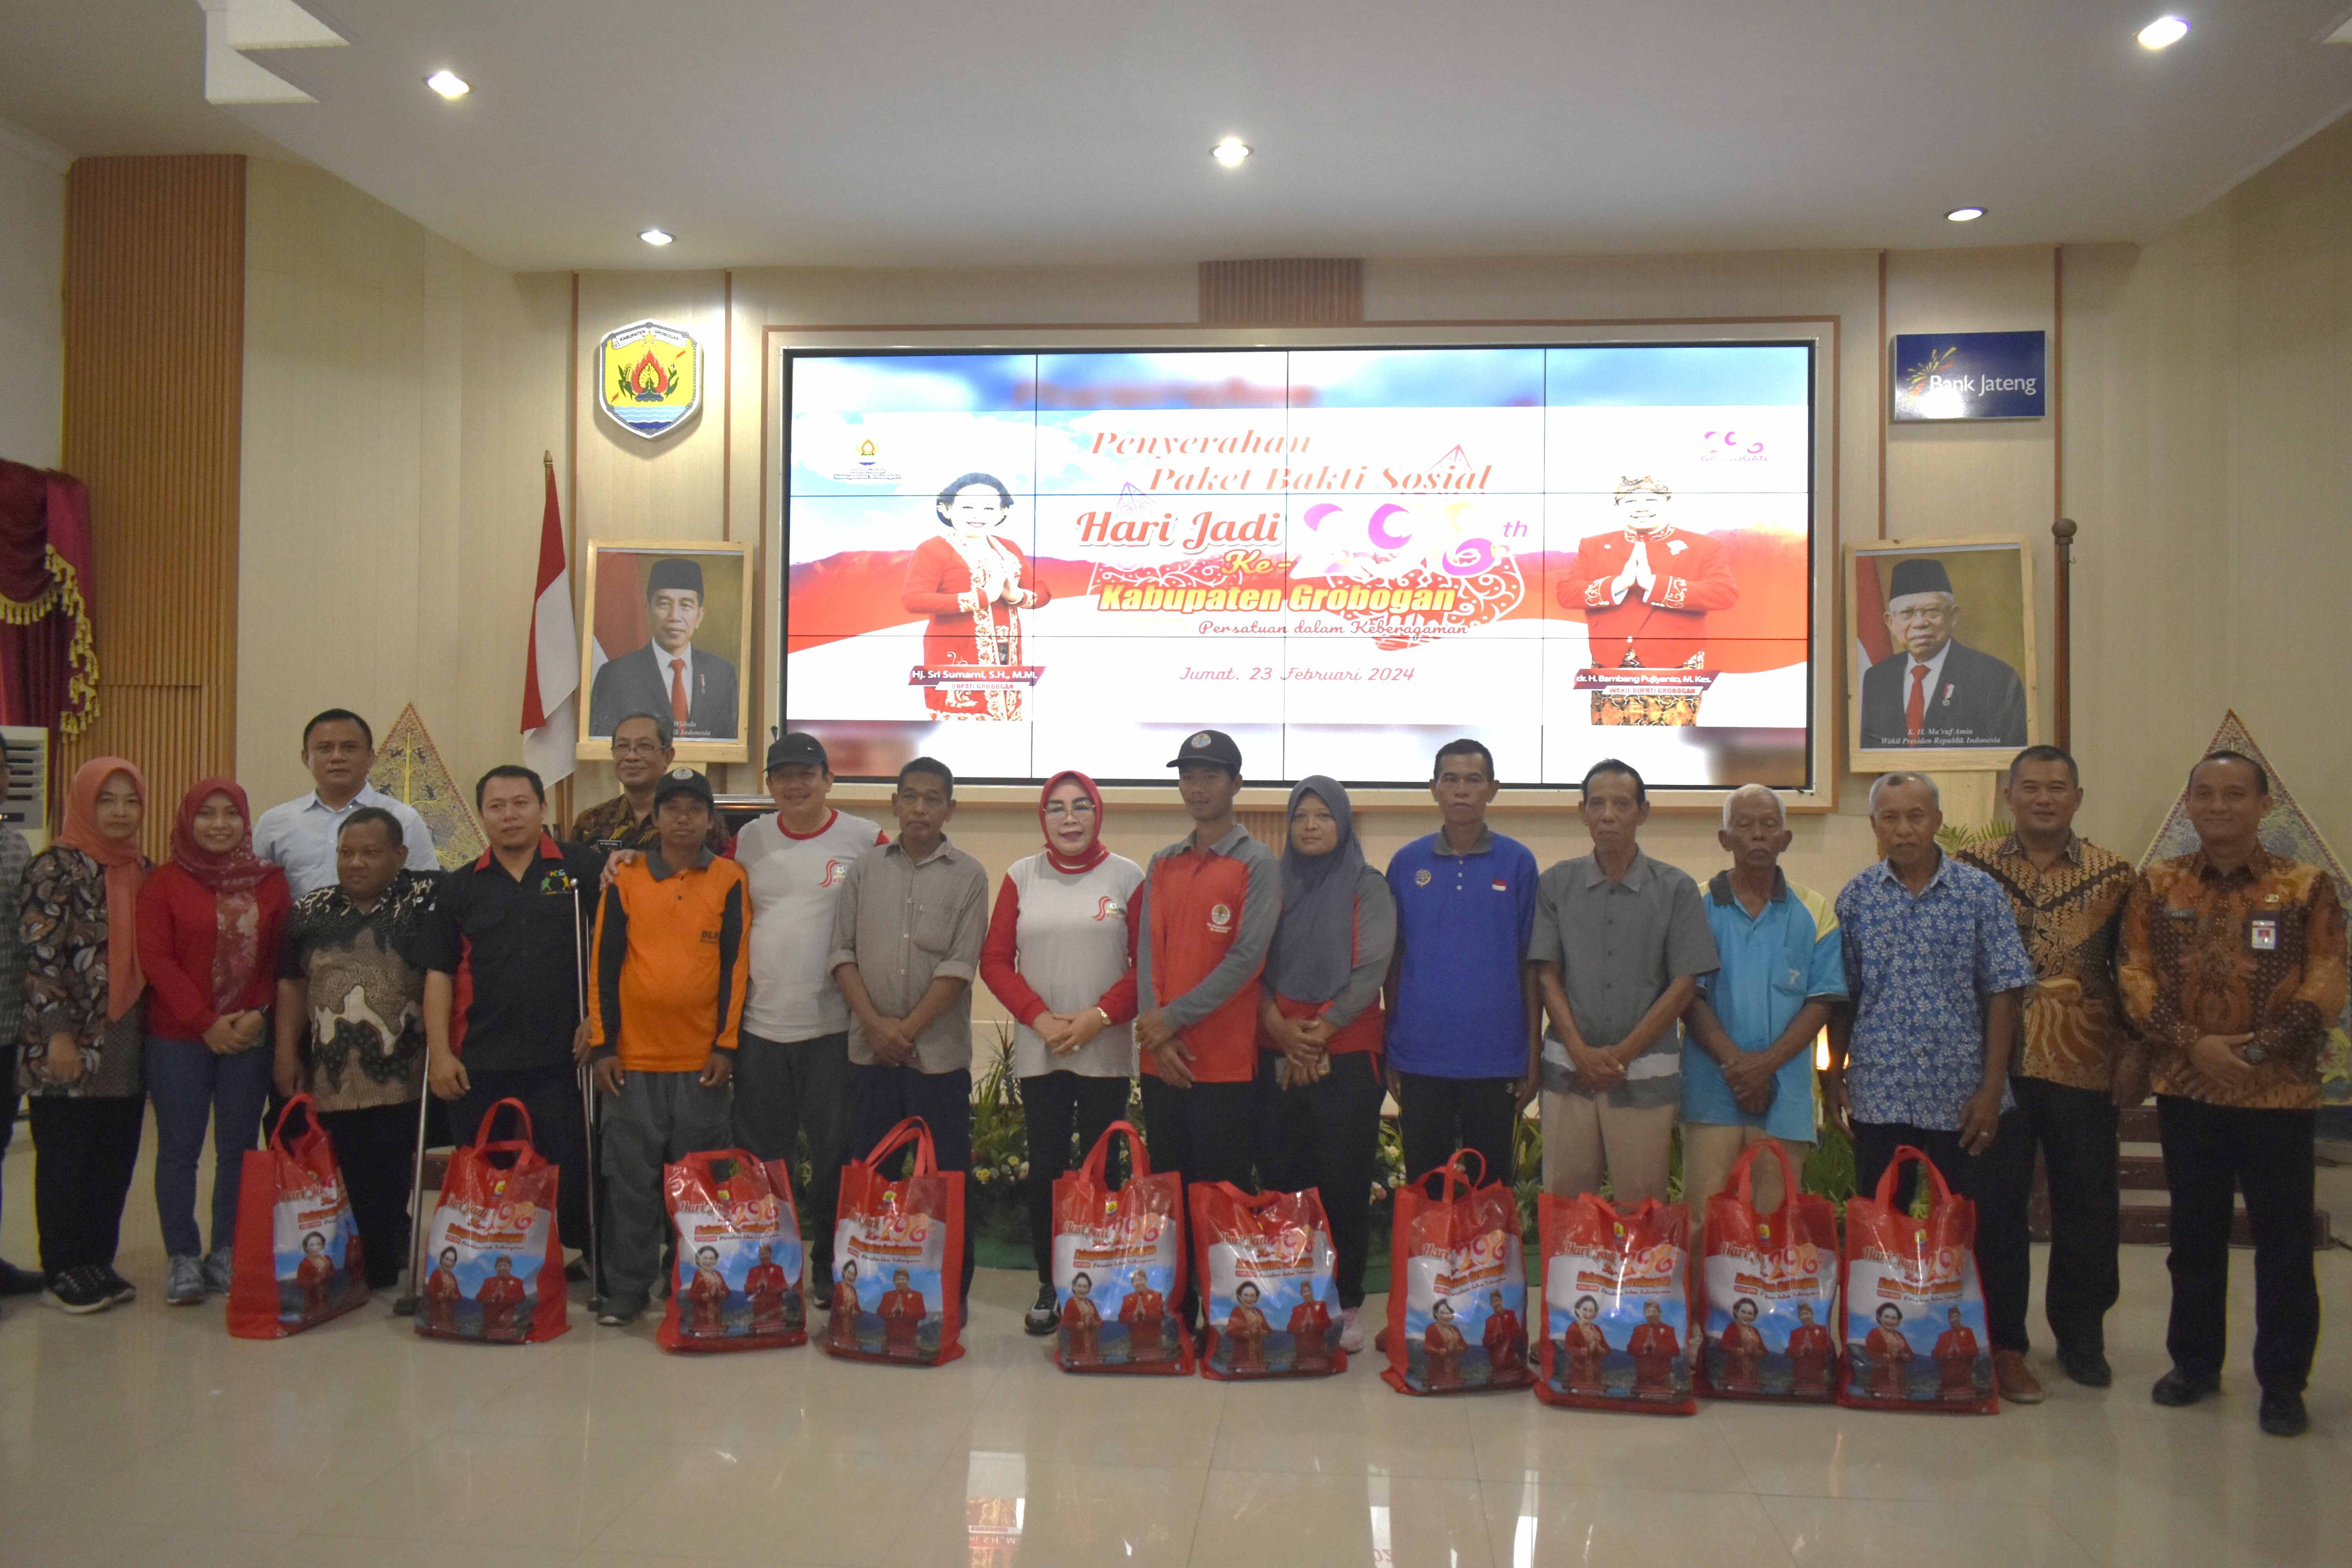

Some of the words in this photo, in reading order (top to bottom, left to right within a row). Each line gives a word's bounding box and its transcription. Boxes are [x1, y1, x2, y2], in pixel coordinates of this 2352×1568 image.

[619, 330, 646, 341] KABUPATEN
[654, 329, 679, 340] GROBOGAN
[1930, 374, 1975, 392] Bank
[1978, 374, 2037, 396] Jateng
[1091, 429, 1311, 459] Penyerahan
[1149, 467, 1253, 490] Paket
[1265, 466, 1368, 490] Bakti
[1382, 465, 1492, 490] Sosial
[1075, 510, 1176, 548] Hari
[1182, 510, 1283, 555] Jadi
[1502, 519, 1529, 538] th
[1221, 550, 1291, 575] Ke-
[1098, 584, 1283, 614] Kabupaten
[1287, 584, 1456, 613] Grobogan
[1198, 620, 1287, 635] Persatuan
[1294, 620, 1345, 634] dalam
[1350, 621, 1469, 641] Keberagaman
[912, 670, 926, 680] Hj.
[942, 670, 986, 679] Sumarni,
[1249, 667, 1273, 681] 23
[1279, 666, 1362, 681] Februari
[1368, 667, 1415, 681] 2024
[1934, 737, 1964, 745] Republik
